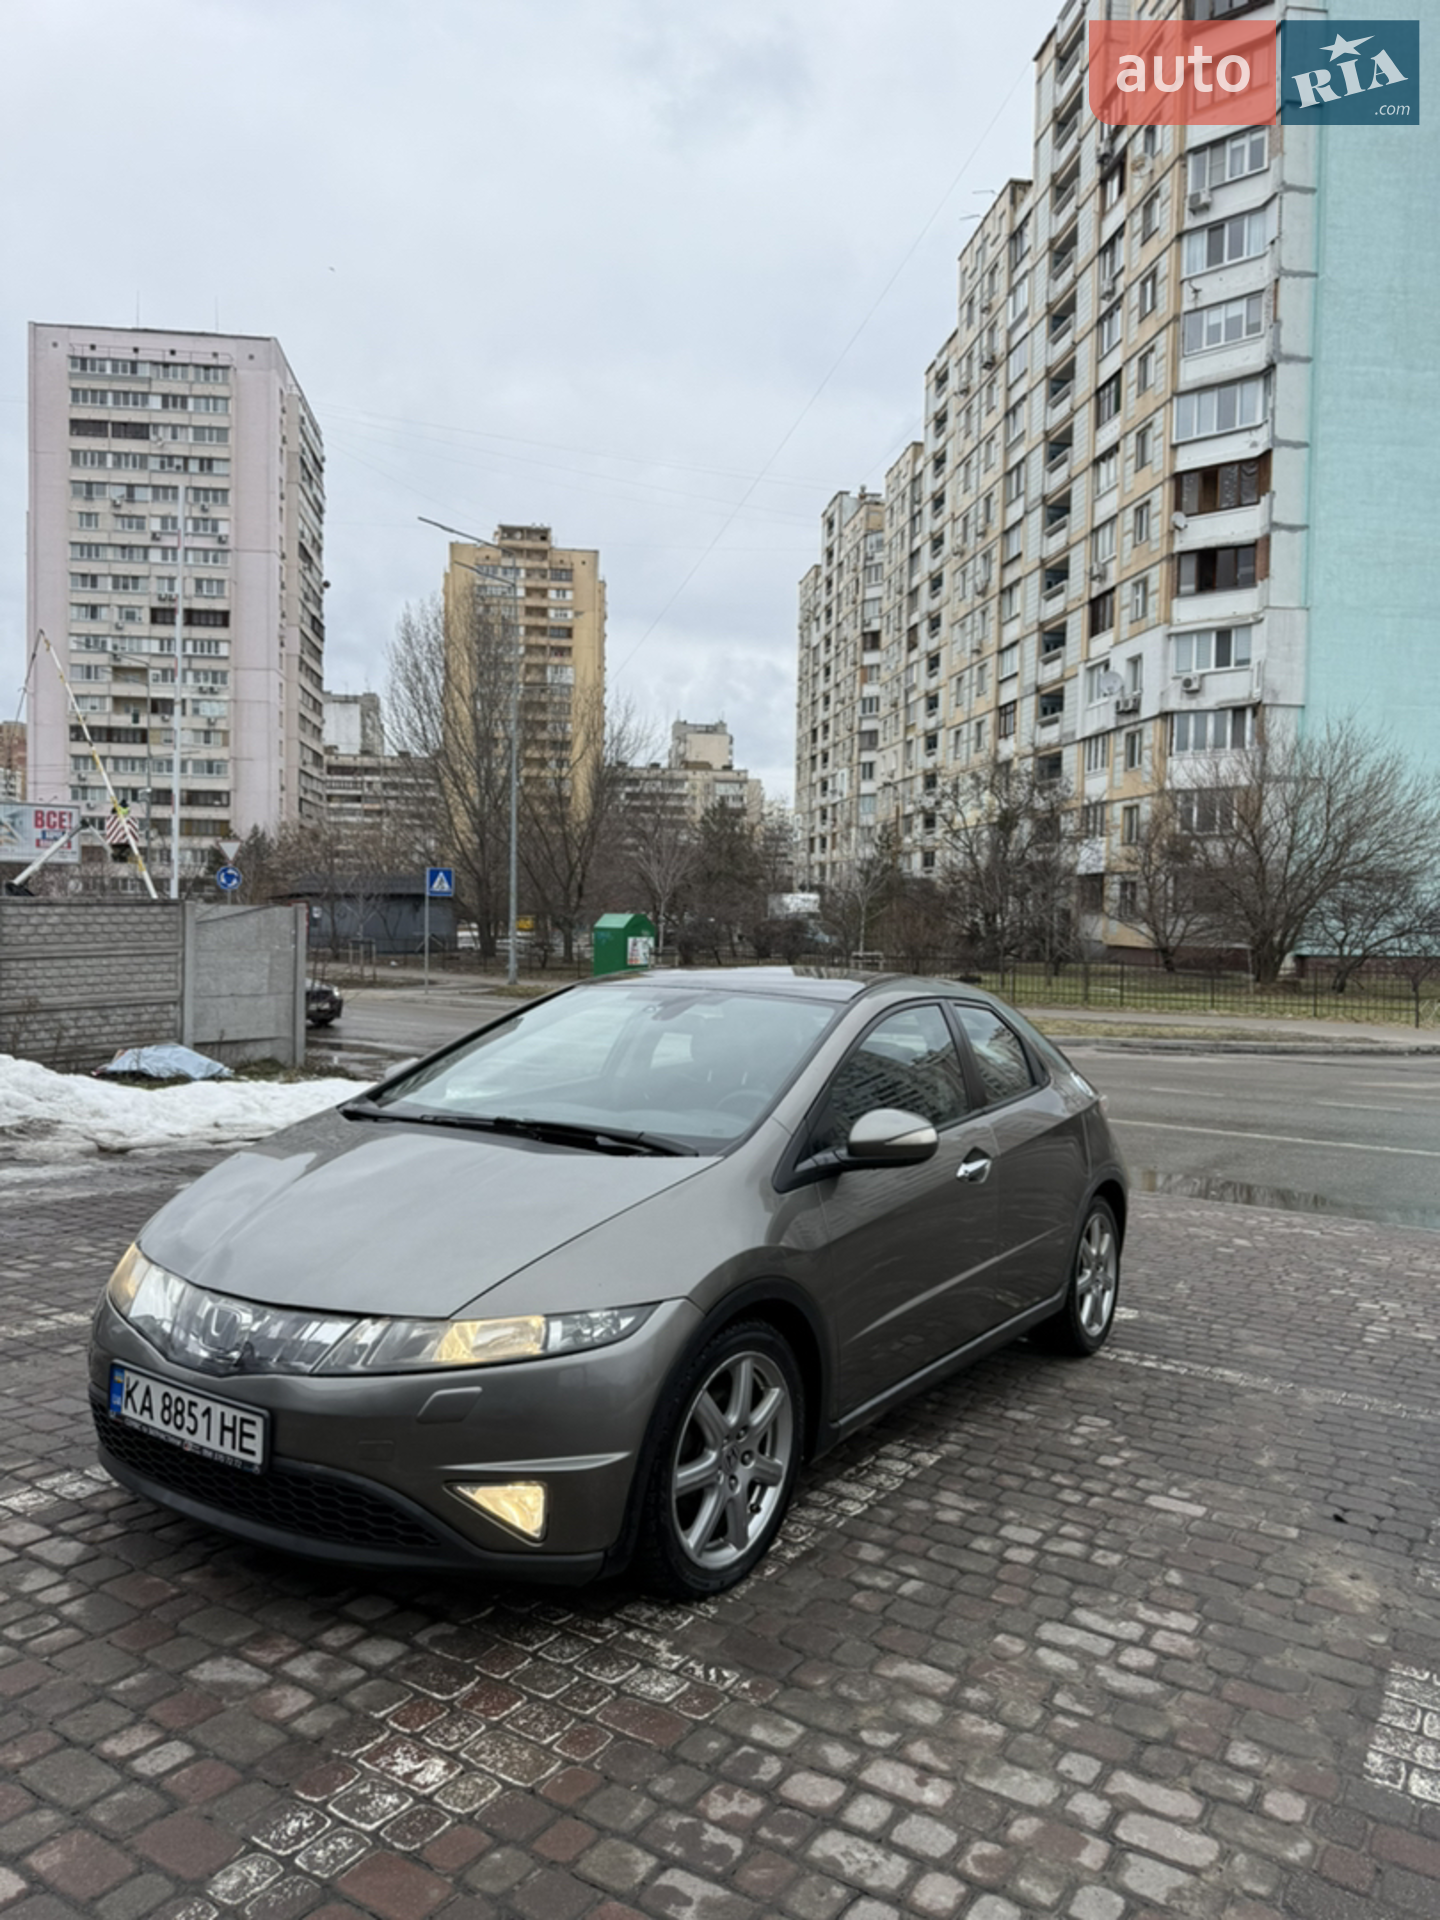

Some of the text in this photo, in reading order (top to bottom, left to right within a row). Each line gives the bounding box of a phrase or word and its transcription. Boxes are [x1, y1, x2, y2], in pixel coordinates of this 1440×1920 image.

[35, 809, 73, 829] ВСЕ!
[124, 1375, 154, 1421] KA
[160, 1391, 212, 1442] 8851
[219, 1410, 257, 1457] HE
